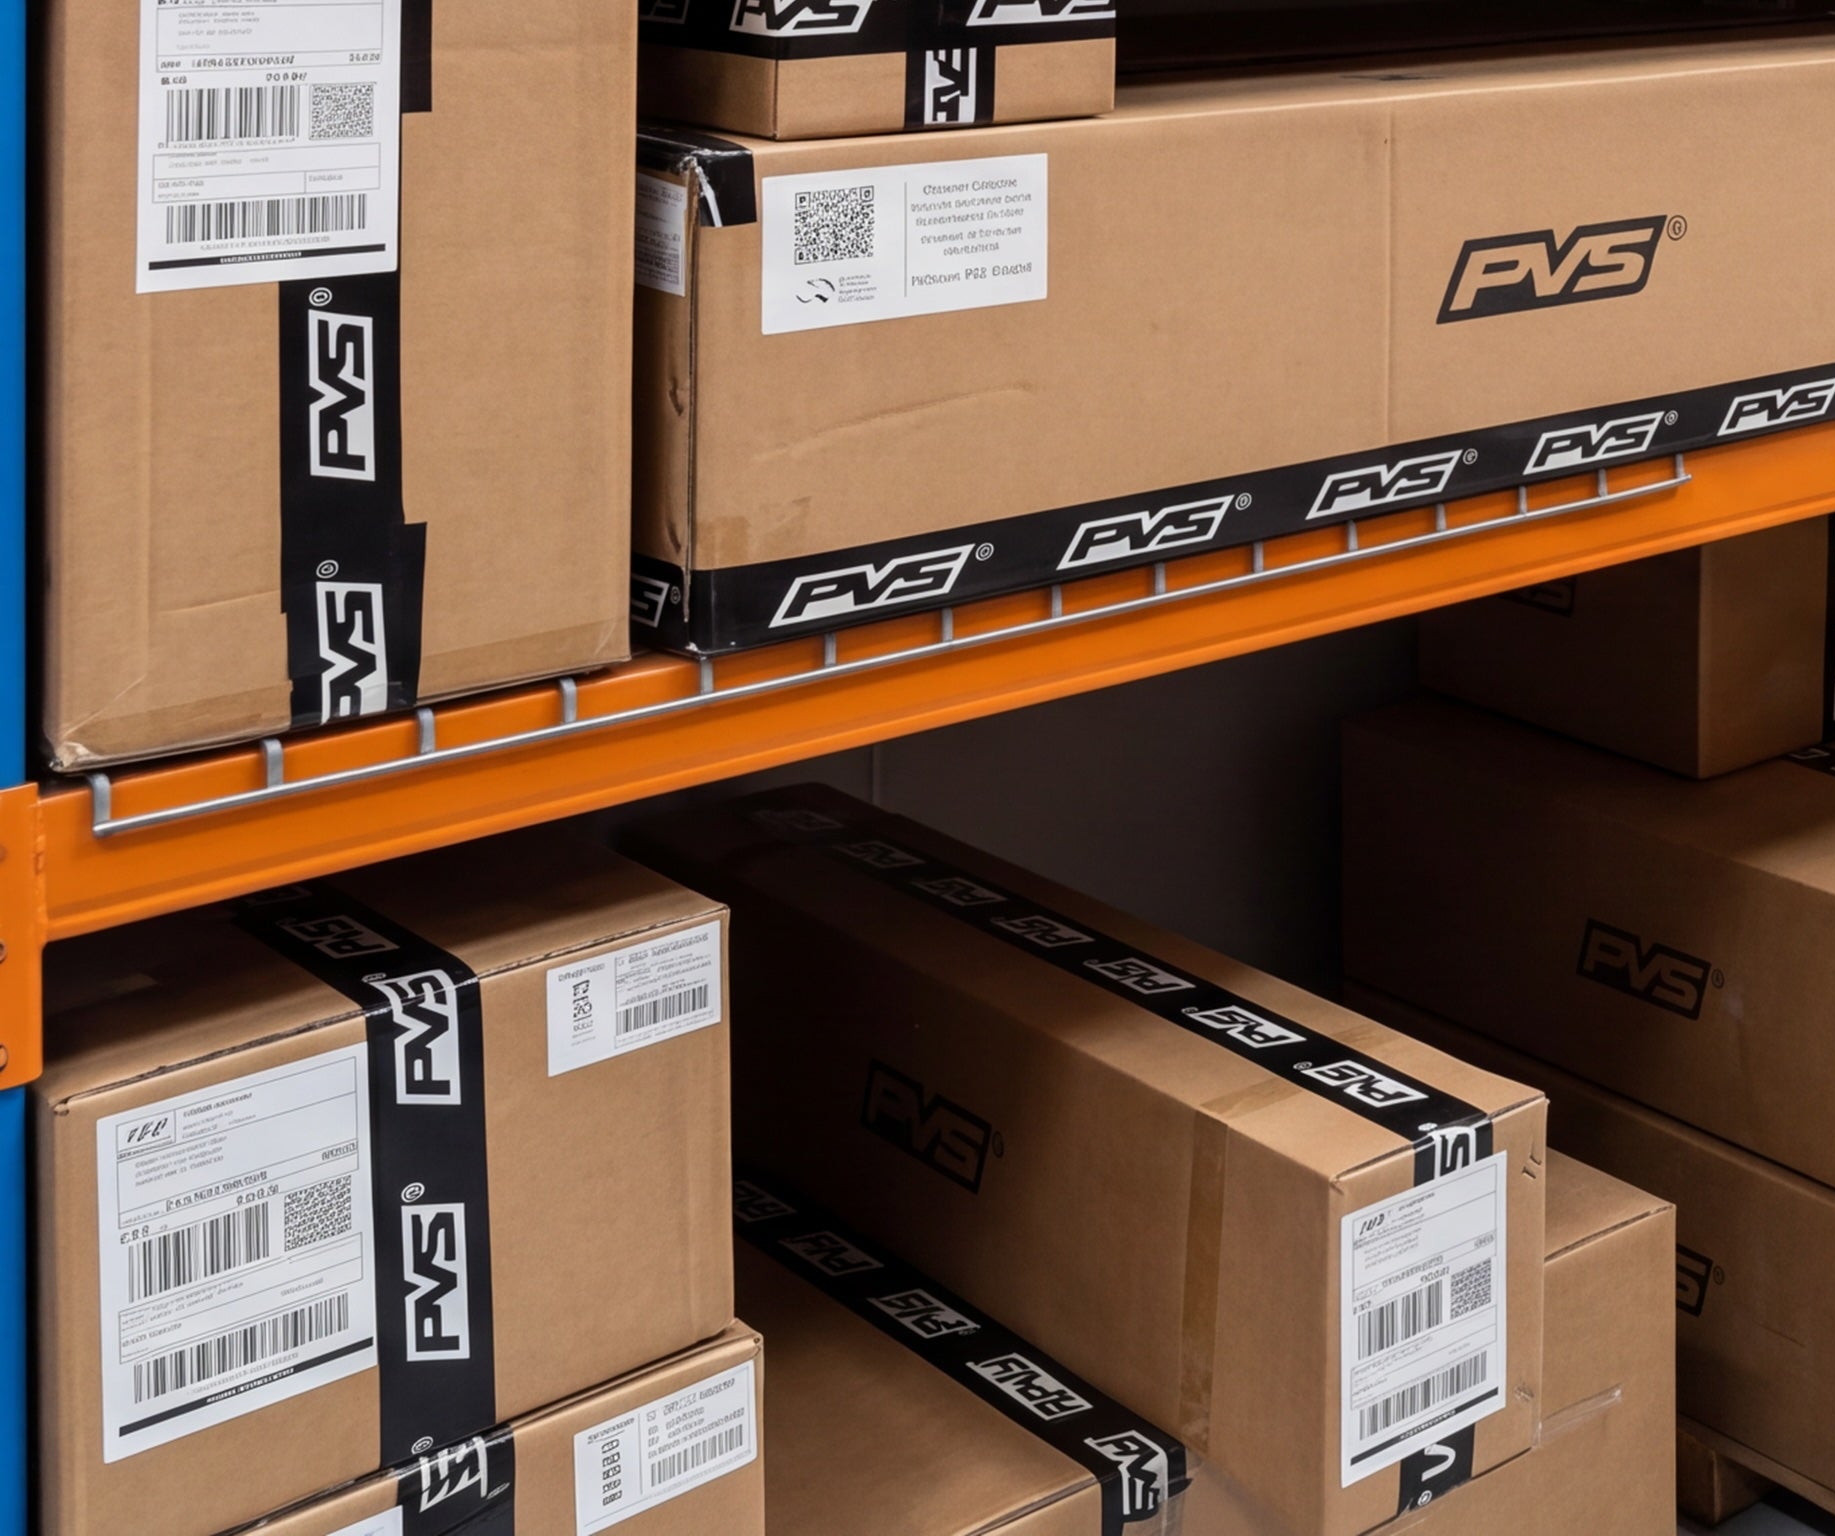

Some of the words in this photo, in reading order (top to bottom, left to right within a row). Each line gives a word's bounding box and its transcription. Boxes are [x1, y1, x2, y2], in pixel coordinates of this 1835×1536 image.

[1450, 228, 1654, 312] PVS
[315, 316, 368, 474] PVS
[780, 550, 963, 621] PVS
[1066, 500, 1226, 564] PVS
[1315, 455, 1455, 514] PVS
[1531, 416, 1658, 470] PVS
[1724, 382, 1835, 432] PVS
[408, 1209, 463, 1355] PVS
